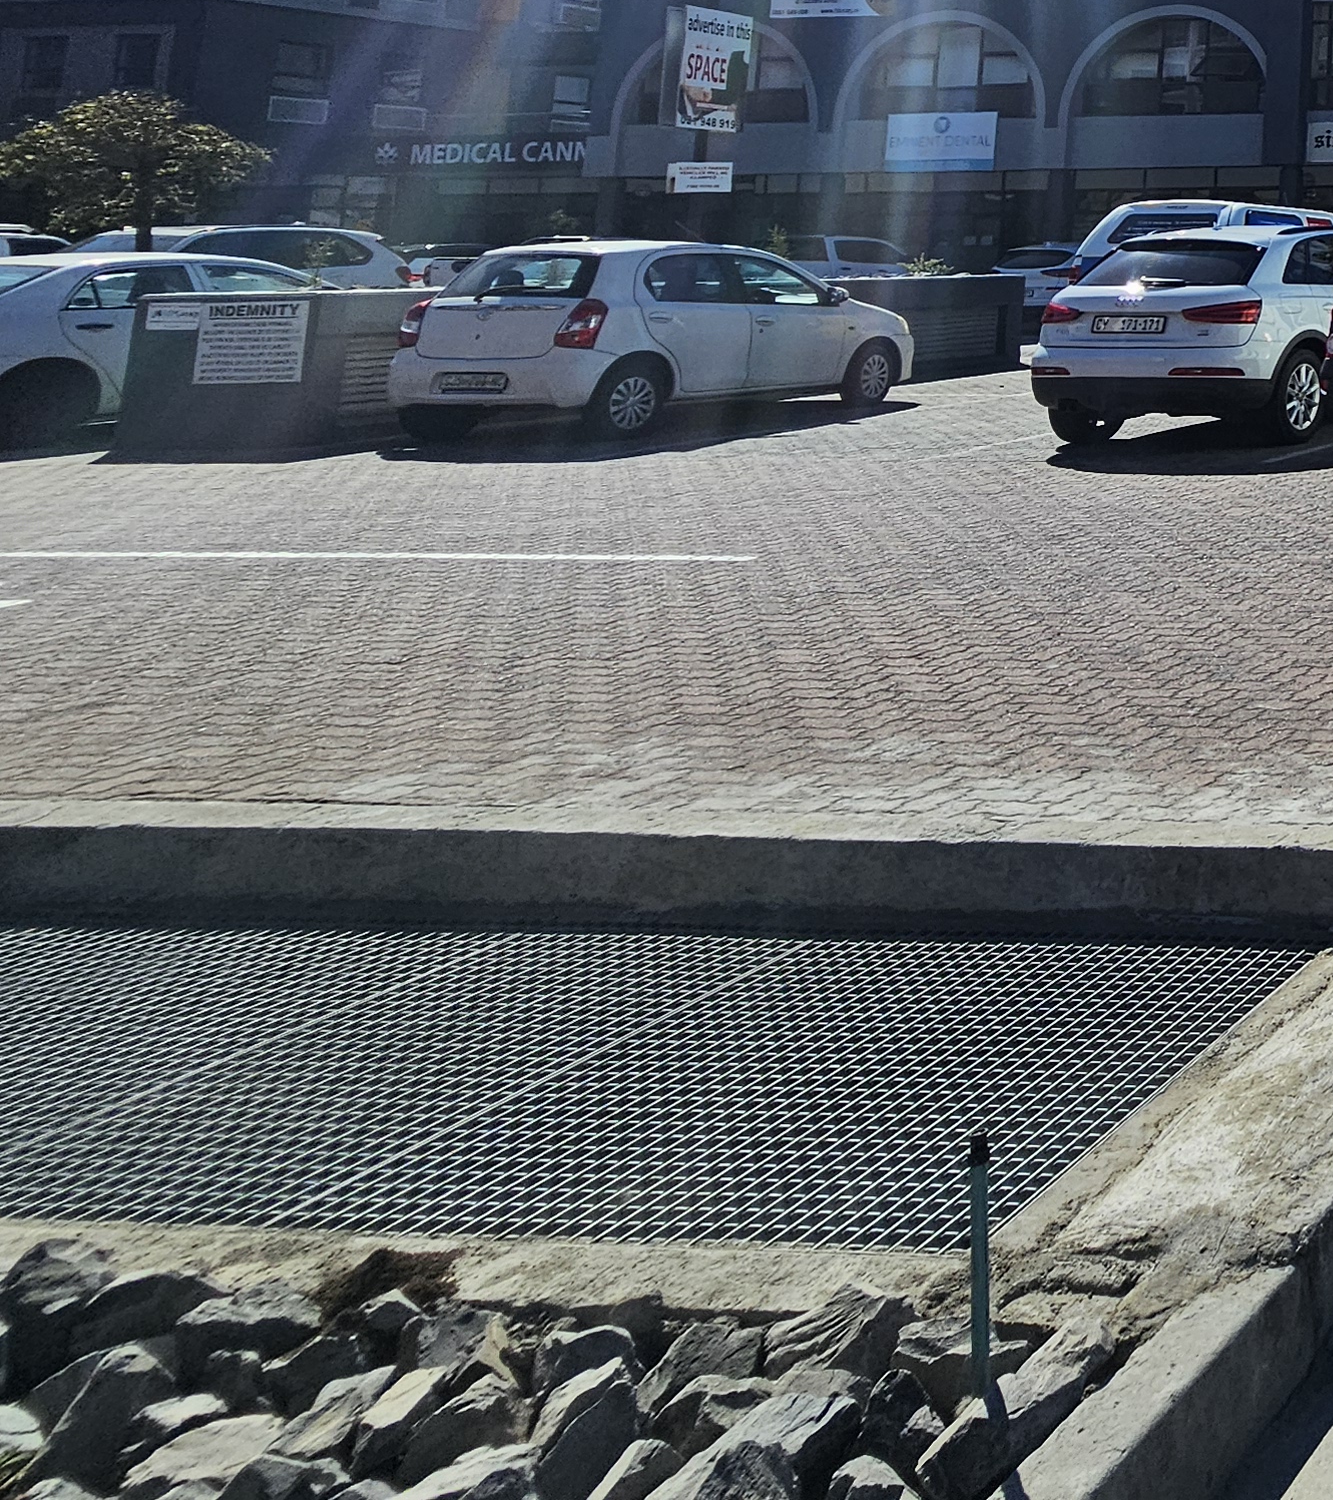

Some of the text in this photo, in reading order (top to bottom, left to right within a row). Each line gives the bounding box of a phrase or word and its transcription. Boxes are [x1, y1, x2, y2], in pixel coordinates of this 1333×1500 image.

[688, 14, 751, 40] advertise in this
[686, 53, 727, 83] SPACE
[410, 142, 516, 165] MEDICAL
[209, 304, 300, 317] INDEMNITY
